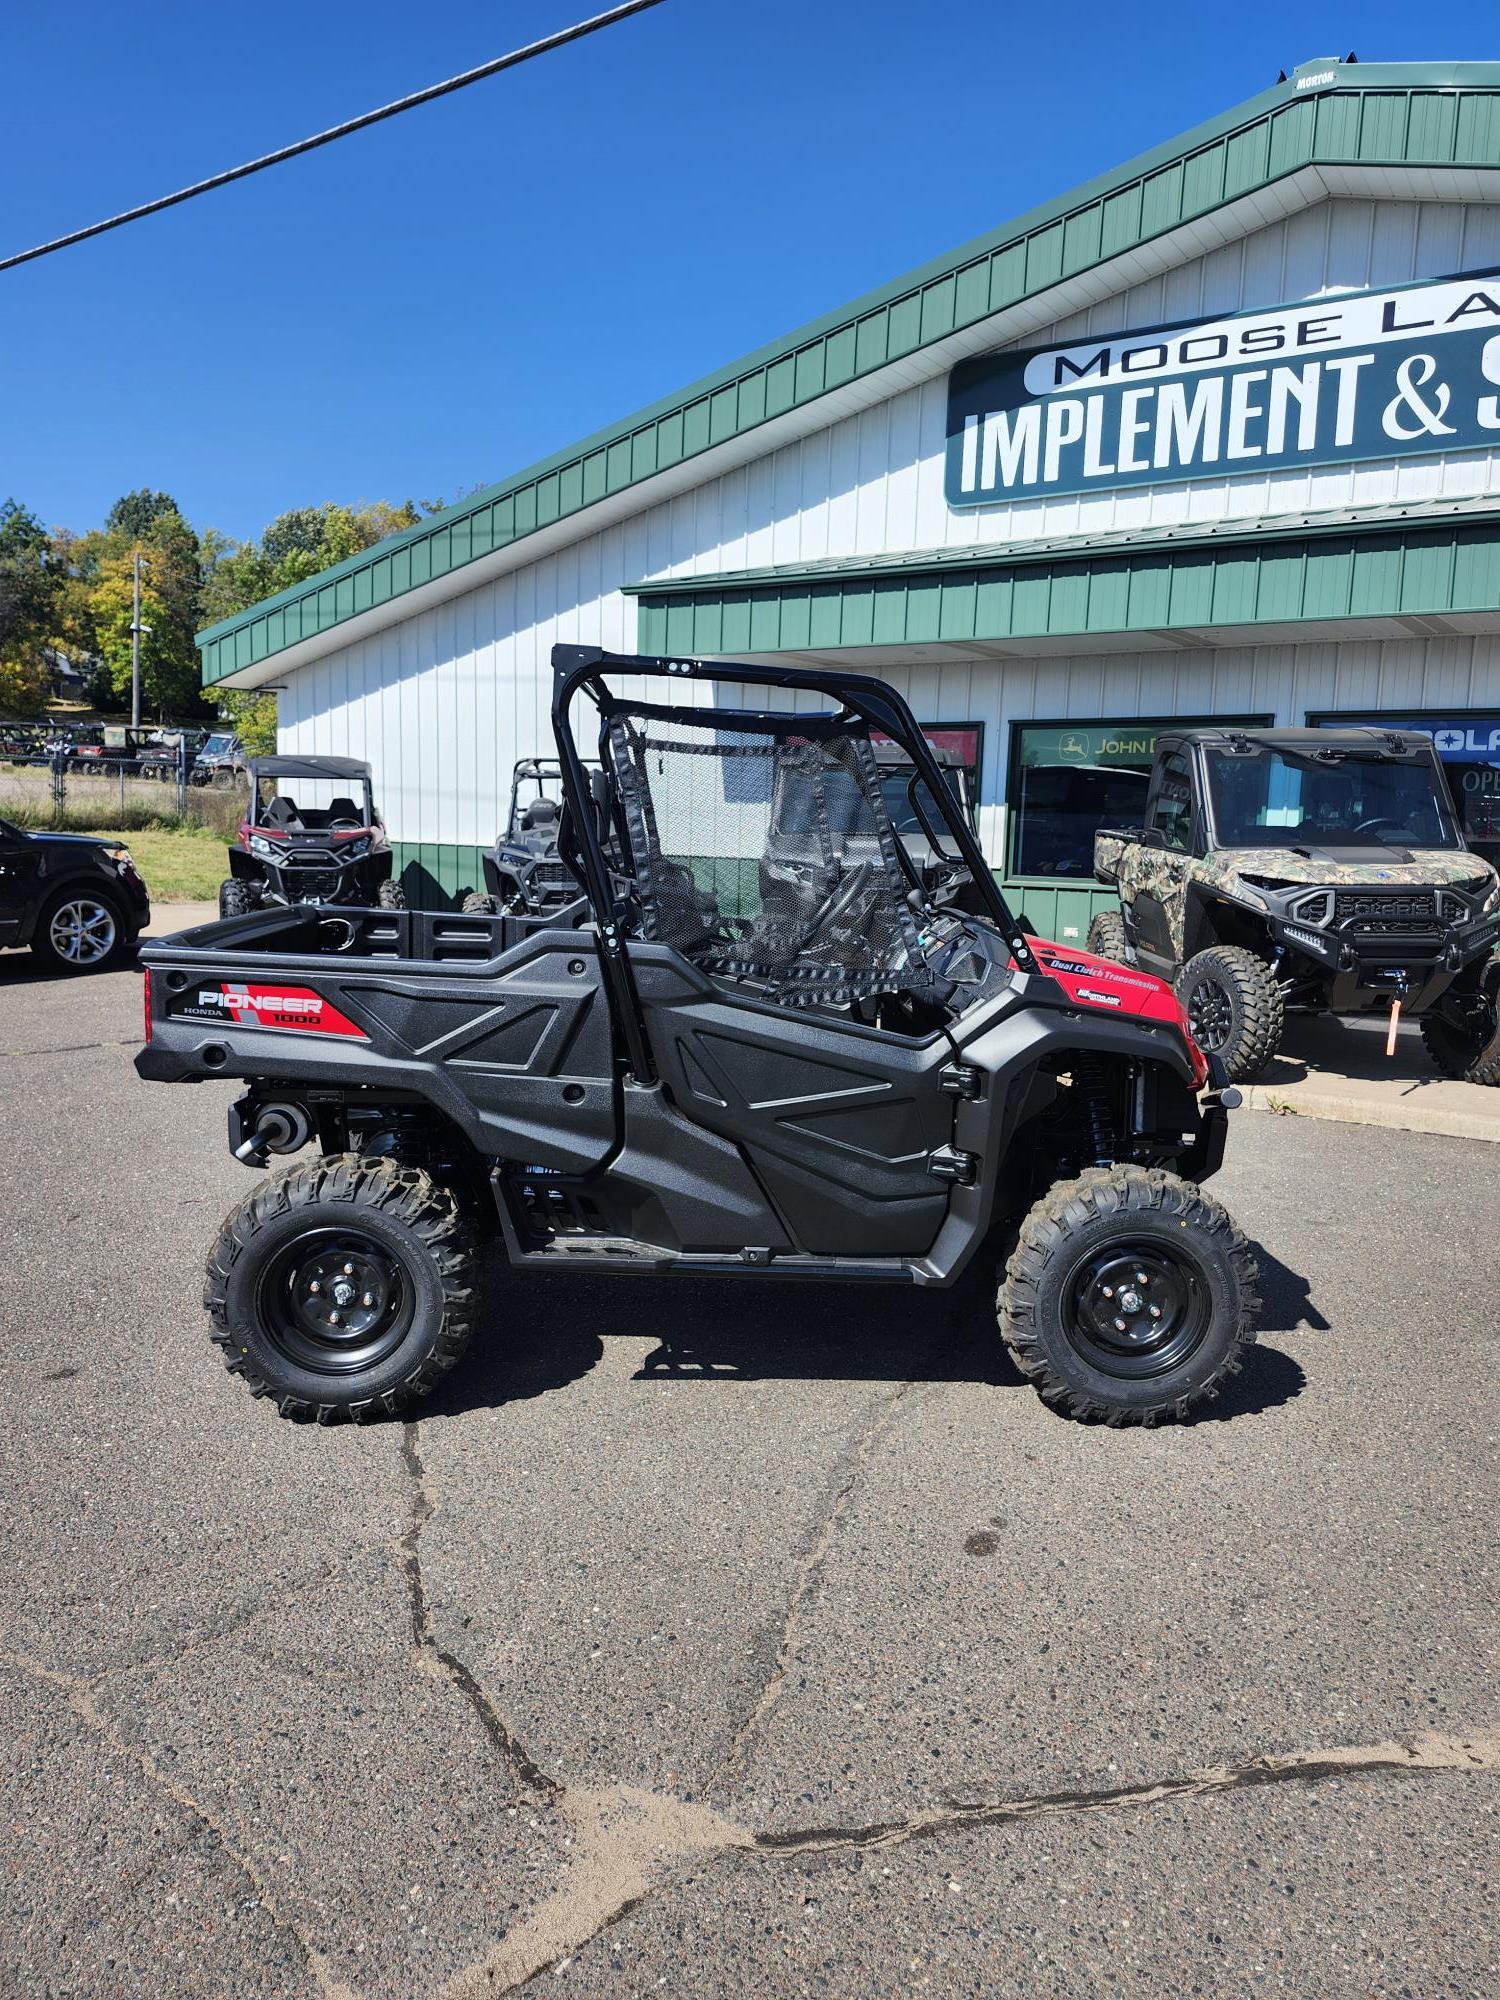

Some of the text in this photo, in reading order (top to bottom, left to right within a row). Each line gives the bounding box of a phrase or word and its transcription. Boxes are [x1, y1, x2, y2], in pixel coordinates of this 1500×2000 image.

[1297, 71, 1334, 90] MORTON
[1054, 314, 1342, 385] MOOSE
[961, 353, 1375, 492] IMPLEMENT
[1382, 354, 1457, 440] &
[1095, 738, 1146, 754] JOHN
[1339, 902, 1429, 916] POLARIS
[1050, 959, 1160, 991] Dual Clutch Transmission
[184, 1007, 223, 1016] HONDA
[198, 991, 322, 1013] PIONEER
[273, 1013, 321, 1025] 1000
